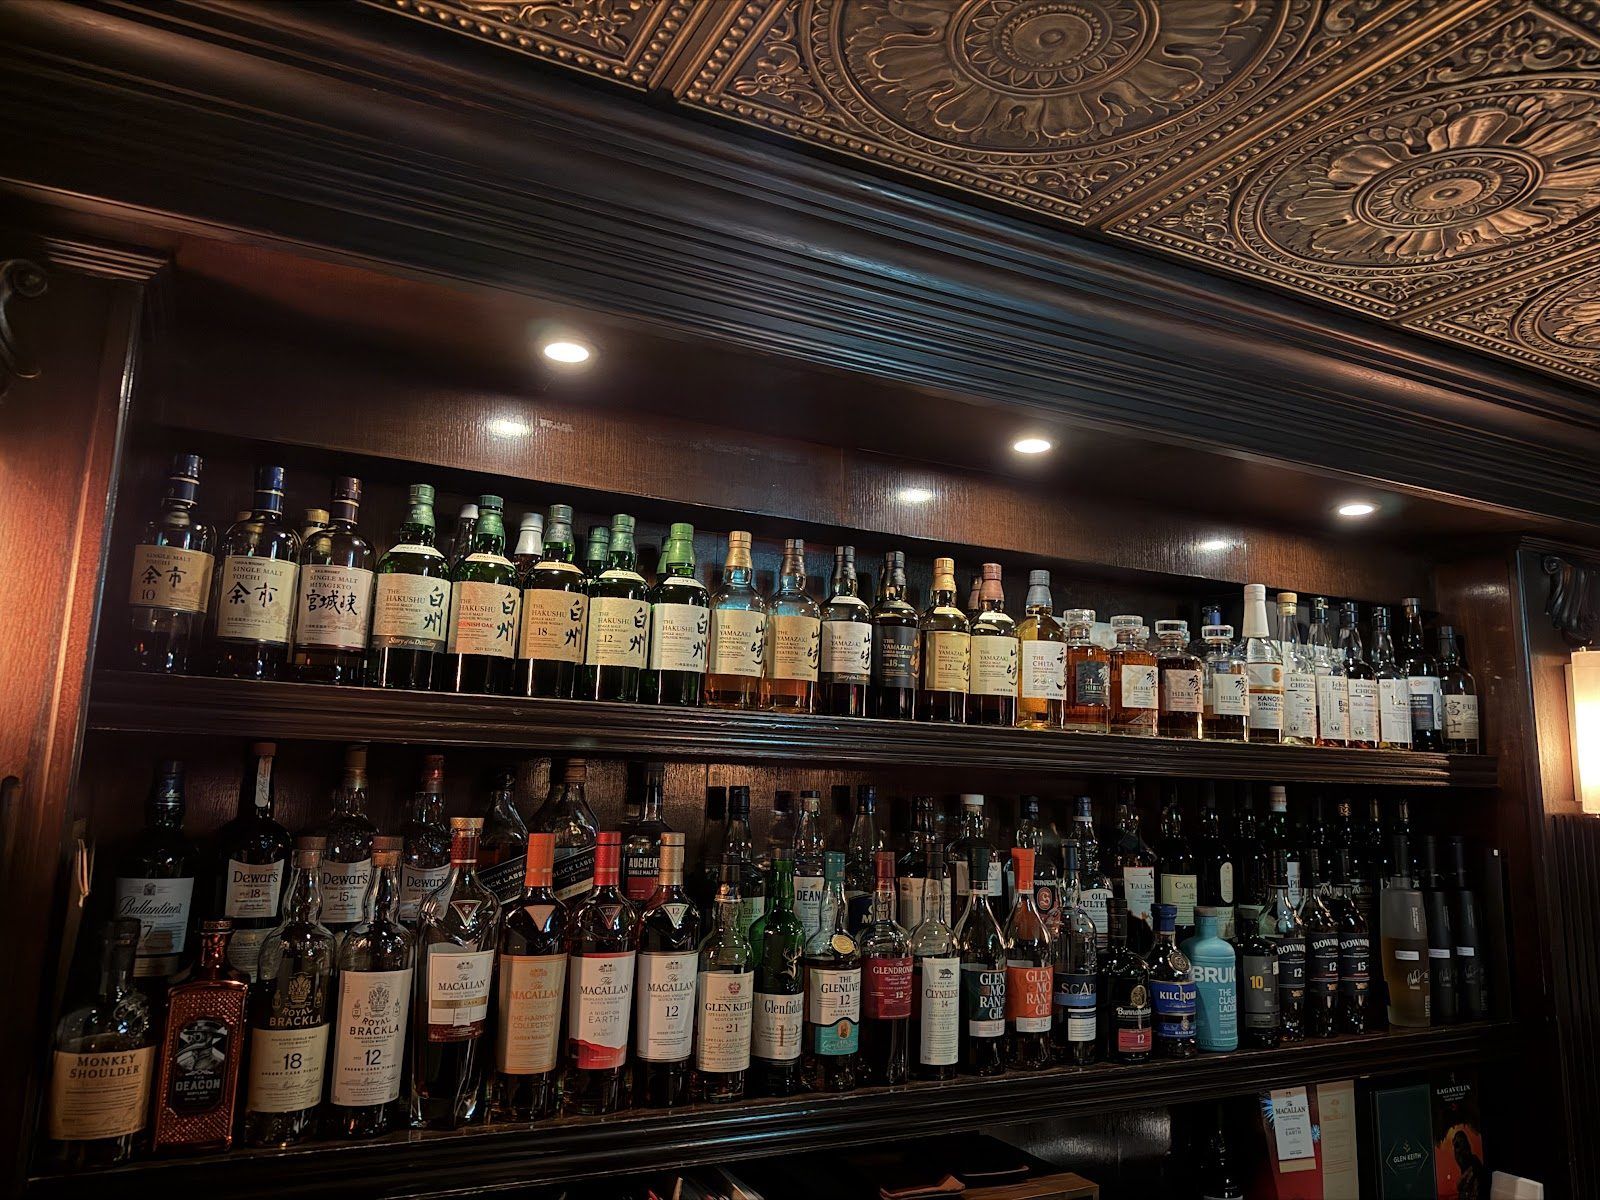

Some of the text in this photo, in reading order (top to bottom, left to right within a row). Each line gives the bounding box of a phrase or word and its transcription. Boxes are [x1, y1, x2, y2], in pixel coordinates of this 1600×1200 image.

[141, 565, 187, 588] 余市
[232, 566, 284, 576] SINGLE MALT
[310, 574, 358, 584] SINGLE MALT
[142, 588, 156, 600] 10
[226, 582, 278, 608] 余市
[386, 595, 426, 604] HAKUSHU
[424, 586, 444, 636] 白州
[496, 592, 516, 646] 白州
[564, 600, 584, 652] 白州
[537, 628, 548, 636] 18
[629, 606, 647, 658] 白州
[693, 613, 708, 660] 白州
[604, 634, 613, 643] 12
[233, 871, 278, 883] Dewar's
[323, 872, 369, 885] Dewar's
[250, 889, 261, 898] 18
[339, 892, 349, 901] 15
[120, 896, 182, 914] Ballantine's
[1329, 962, 1337, 971] 12
[1357, 961, 1366, 971] 15
[458, 973, 470, 981] The
[668, 974, 679, 982] The
[1026, 971, 1050, 982] GLEN
[1293, 968, 1302, 977] 12
[600, 977, 612, 985] The
[980, 973, 1005, 984] GLEN
[1250, 975, 1264, 989] 10
[438, 980, 485, 991] MACALLAN
[580, 984, 629, 995] MACALLAN
[648, 981, 694, 992] MACALLAN
[990, 985, 1005, 996] MO
[1036, 983, 1050, 992] MO
[512, 990, 559, 1000] MACALLAN
[840, 994, 850, 1005] 12
[1026, 993, 1046, 1004] RAN
[980, 996, 1000, 1007] RAN
[282, 1006, 313, 1017] ROYAL
[665, 1005, 679, 1017] 12
[705, 1003, 730, 1012] GLEN
[989, 1007, 1003, 1019] GIE
[1035, 1005, 1049, 1015] GIE
[269, 1015, 321, 1026] BRACKLA
[362, 1017, 391, 1026] ROYAL
[588, 1015, 620, 1024] EARTH
[349, 1024, 399, 1035] BRACKLA
[726, 1024, 738, 1032] 21
[1137, 1035, 1145, 1043] 12
[77, 1054, 136, 1067] MONKEY
[283, 1053, 302, 1070] 18
[365, 1049, 382, 1066] 12
[69, 1064, 140, 1078] SHOULDER
[176, 1078, 220, 1092] DEACON
[1436, 1084, 1471, 1095] LAGAVULIN
[1276, 1106, 1306, 1114] MACALLAN
